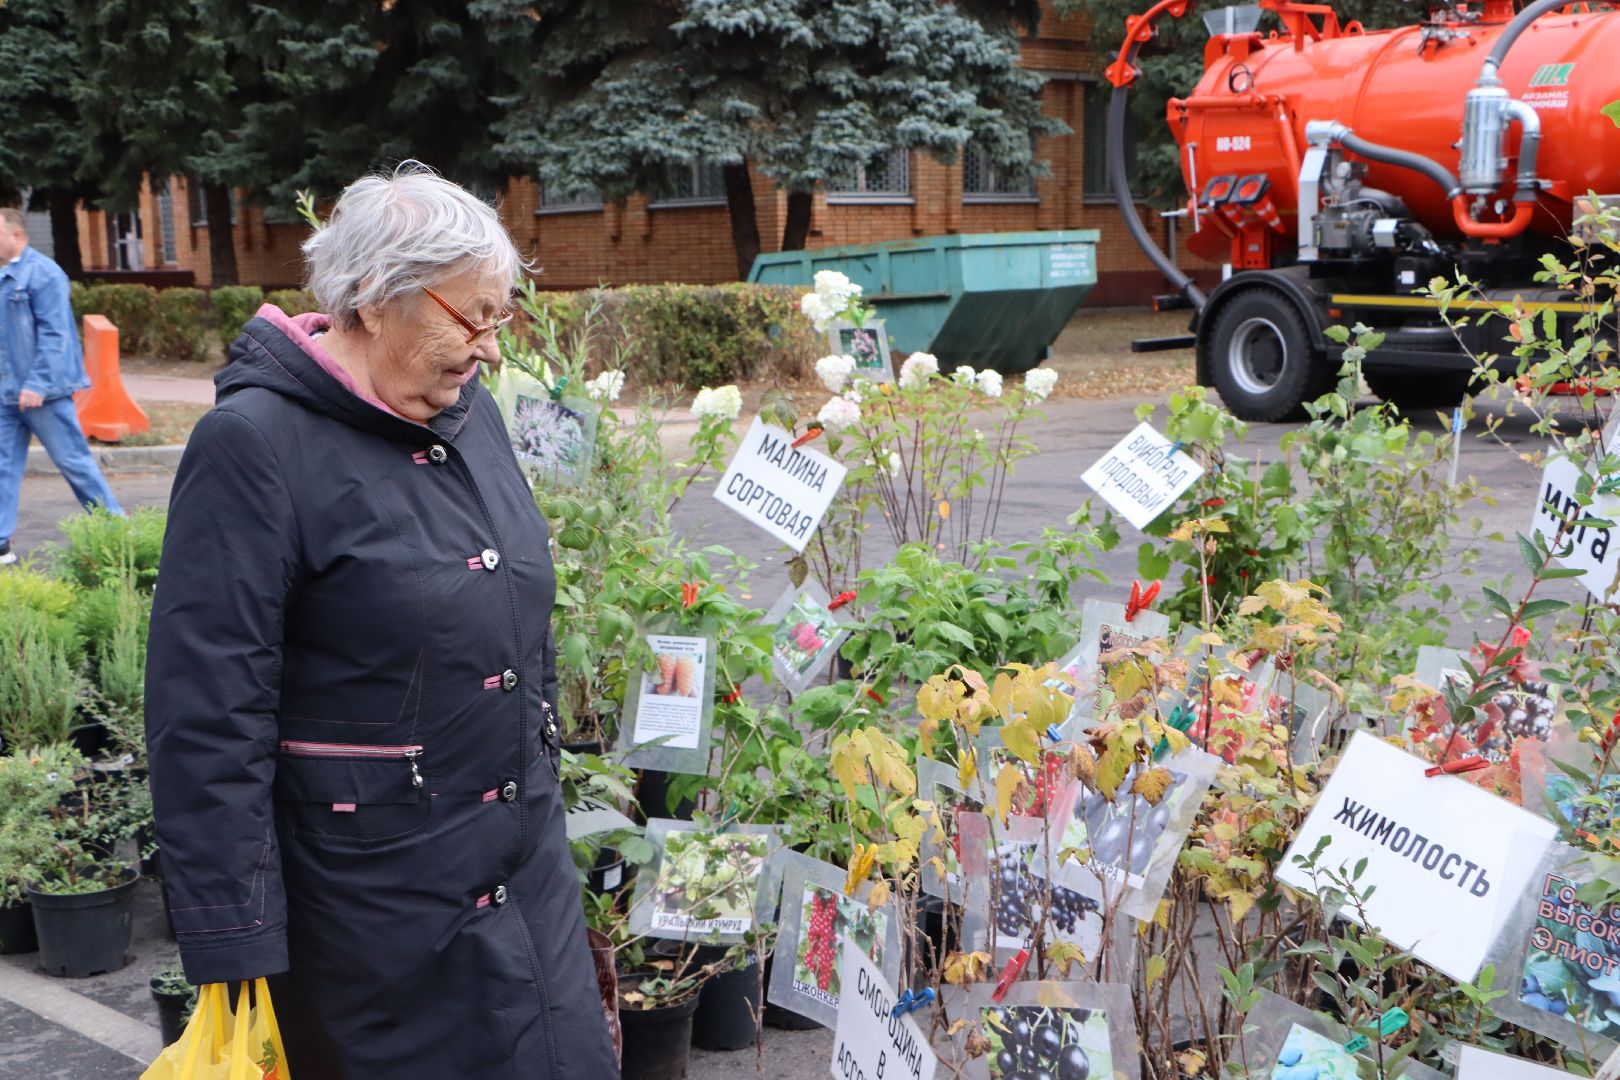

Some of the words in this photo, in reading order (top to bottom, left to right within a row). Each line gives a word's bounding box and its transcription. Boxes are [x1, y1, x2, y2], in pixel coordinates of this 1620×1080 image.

[1216, 135, 1252, 152] КО-524
[757, 432, 829, 493] МАЛИНА
[1099, 456, 1169, 513] ПЛОДОВЫЙ
[1126, 434, 1189, 490] ВИНОГРАД
[726, 472, 814, 540] СОРТОВАЯ
[1541, 482, 1612, 564] ирга
[1333, 796, 1491, 898] ЖИМОЛОСТЬ
[1530, 925, 1619, 977] Элиот
[792, 979, 840, 1007] ДЖОНКЕР
[857, 966, 924, 1080] СМОРОДИНА
